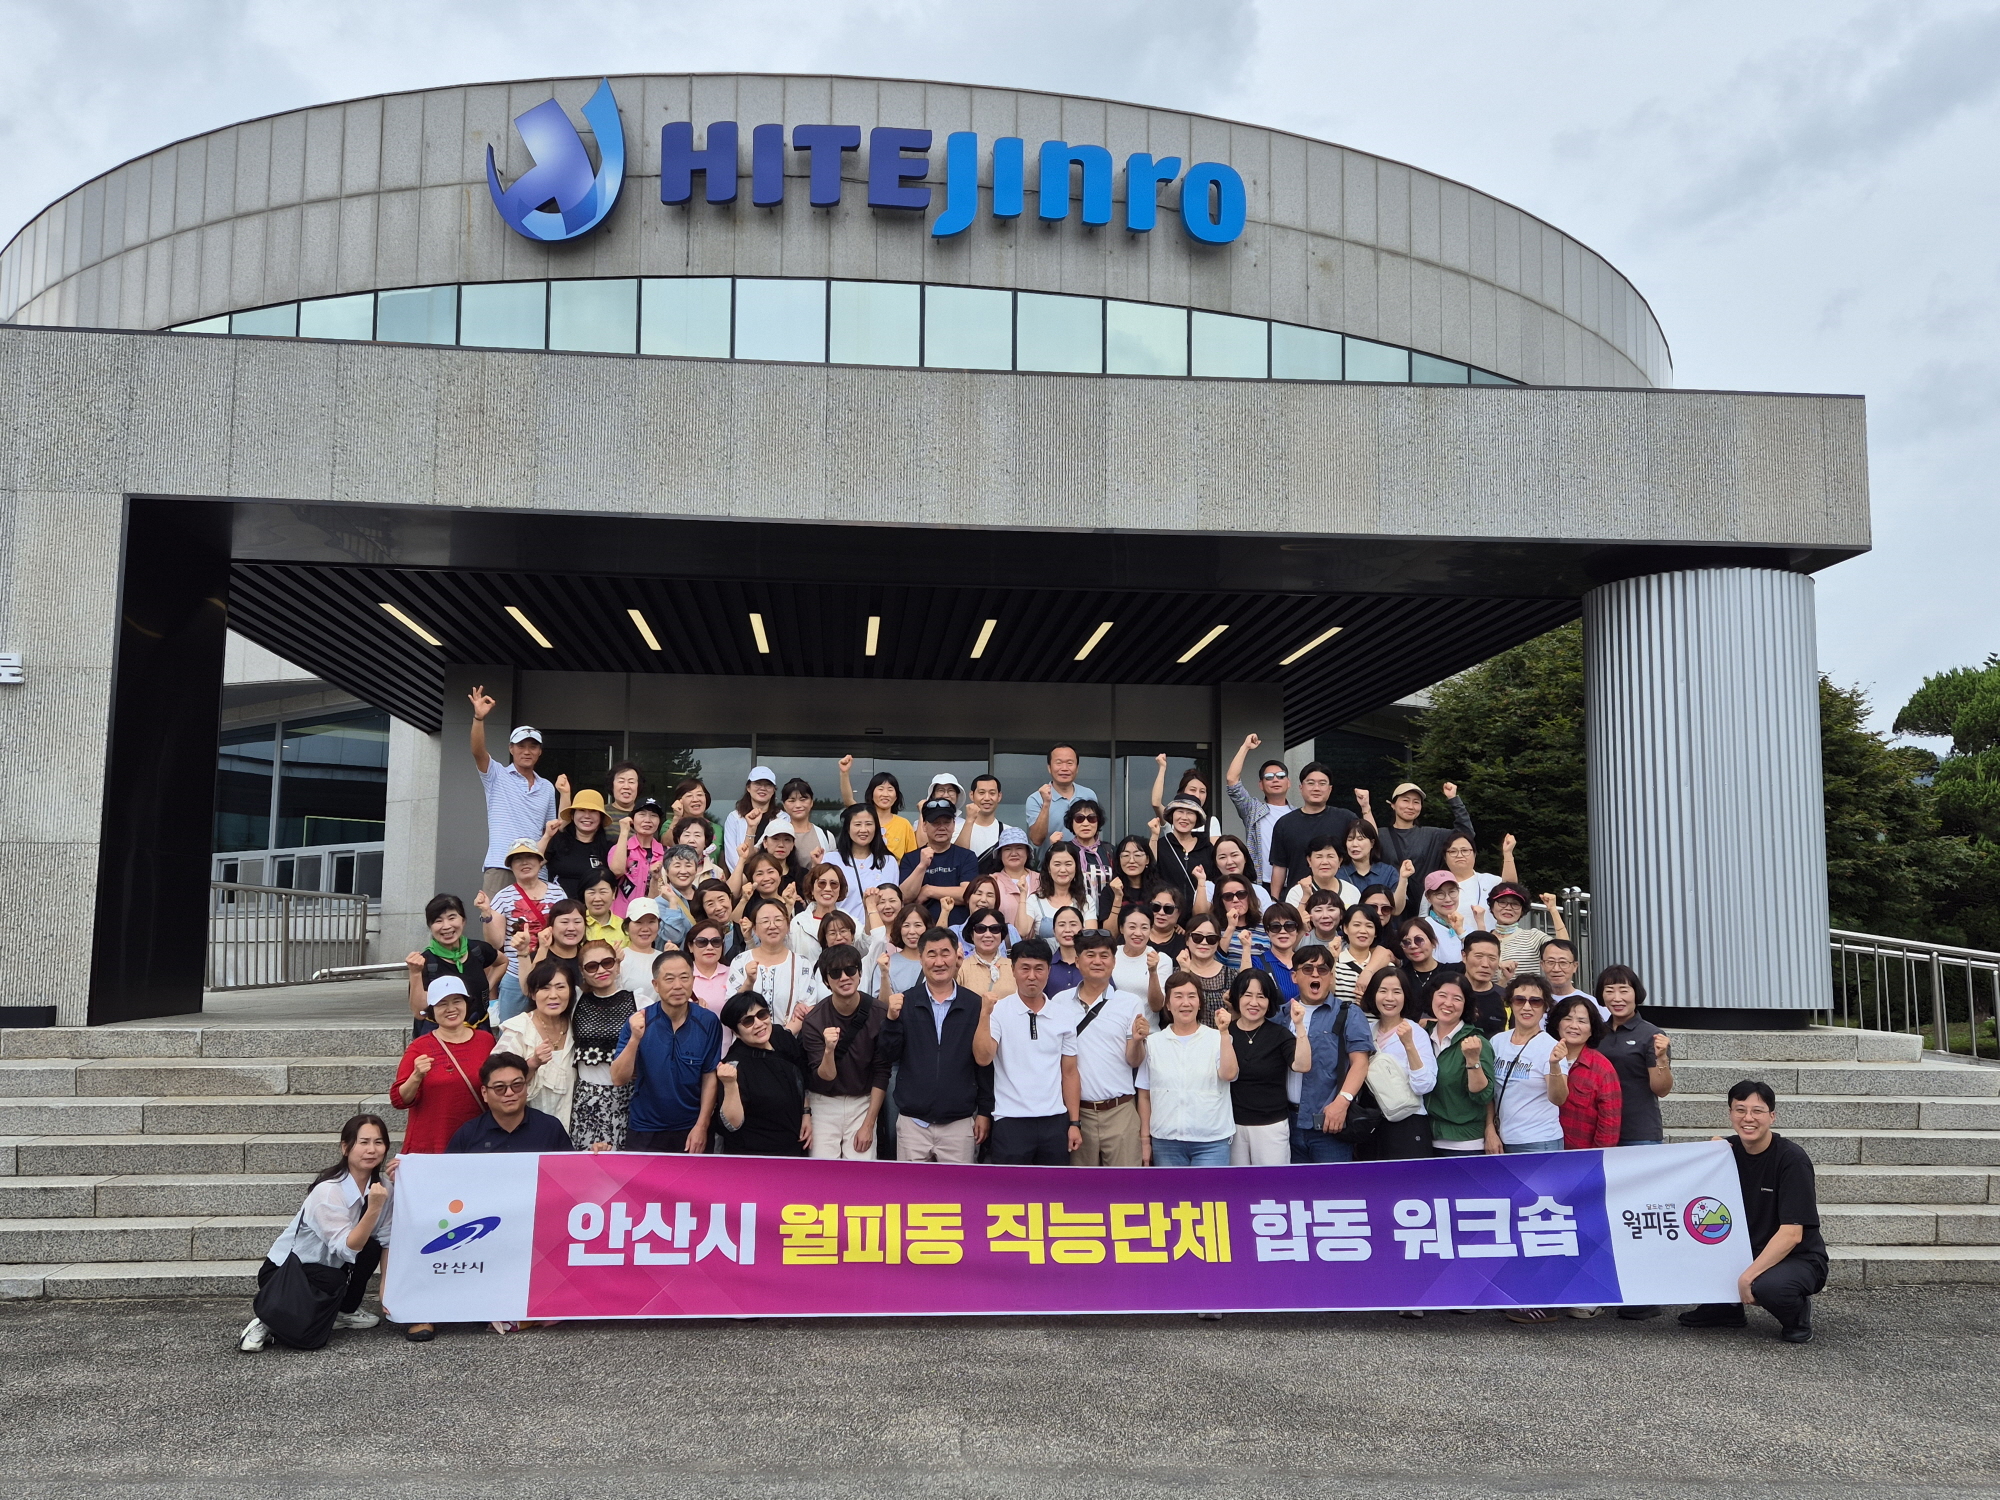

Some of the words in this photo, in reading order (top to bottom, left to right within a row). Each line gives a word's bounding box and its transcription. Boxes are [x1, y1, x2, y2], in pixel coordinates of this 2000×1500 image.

[567, 1202, 757, 1266] 안산시
[779, 1203, 964, 1265] 월피동
[986, 1201, 1232, 1264] 직능단체
[1250, 1199, 1373, 1262] 합동
[1393, 1195, 1580, 1260] 워크숍
[1622, 1209, 1680, 1241] 월피동
[432, 1261, 484, 1275] 안산시
